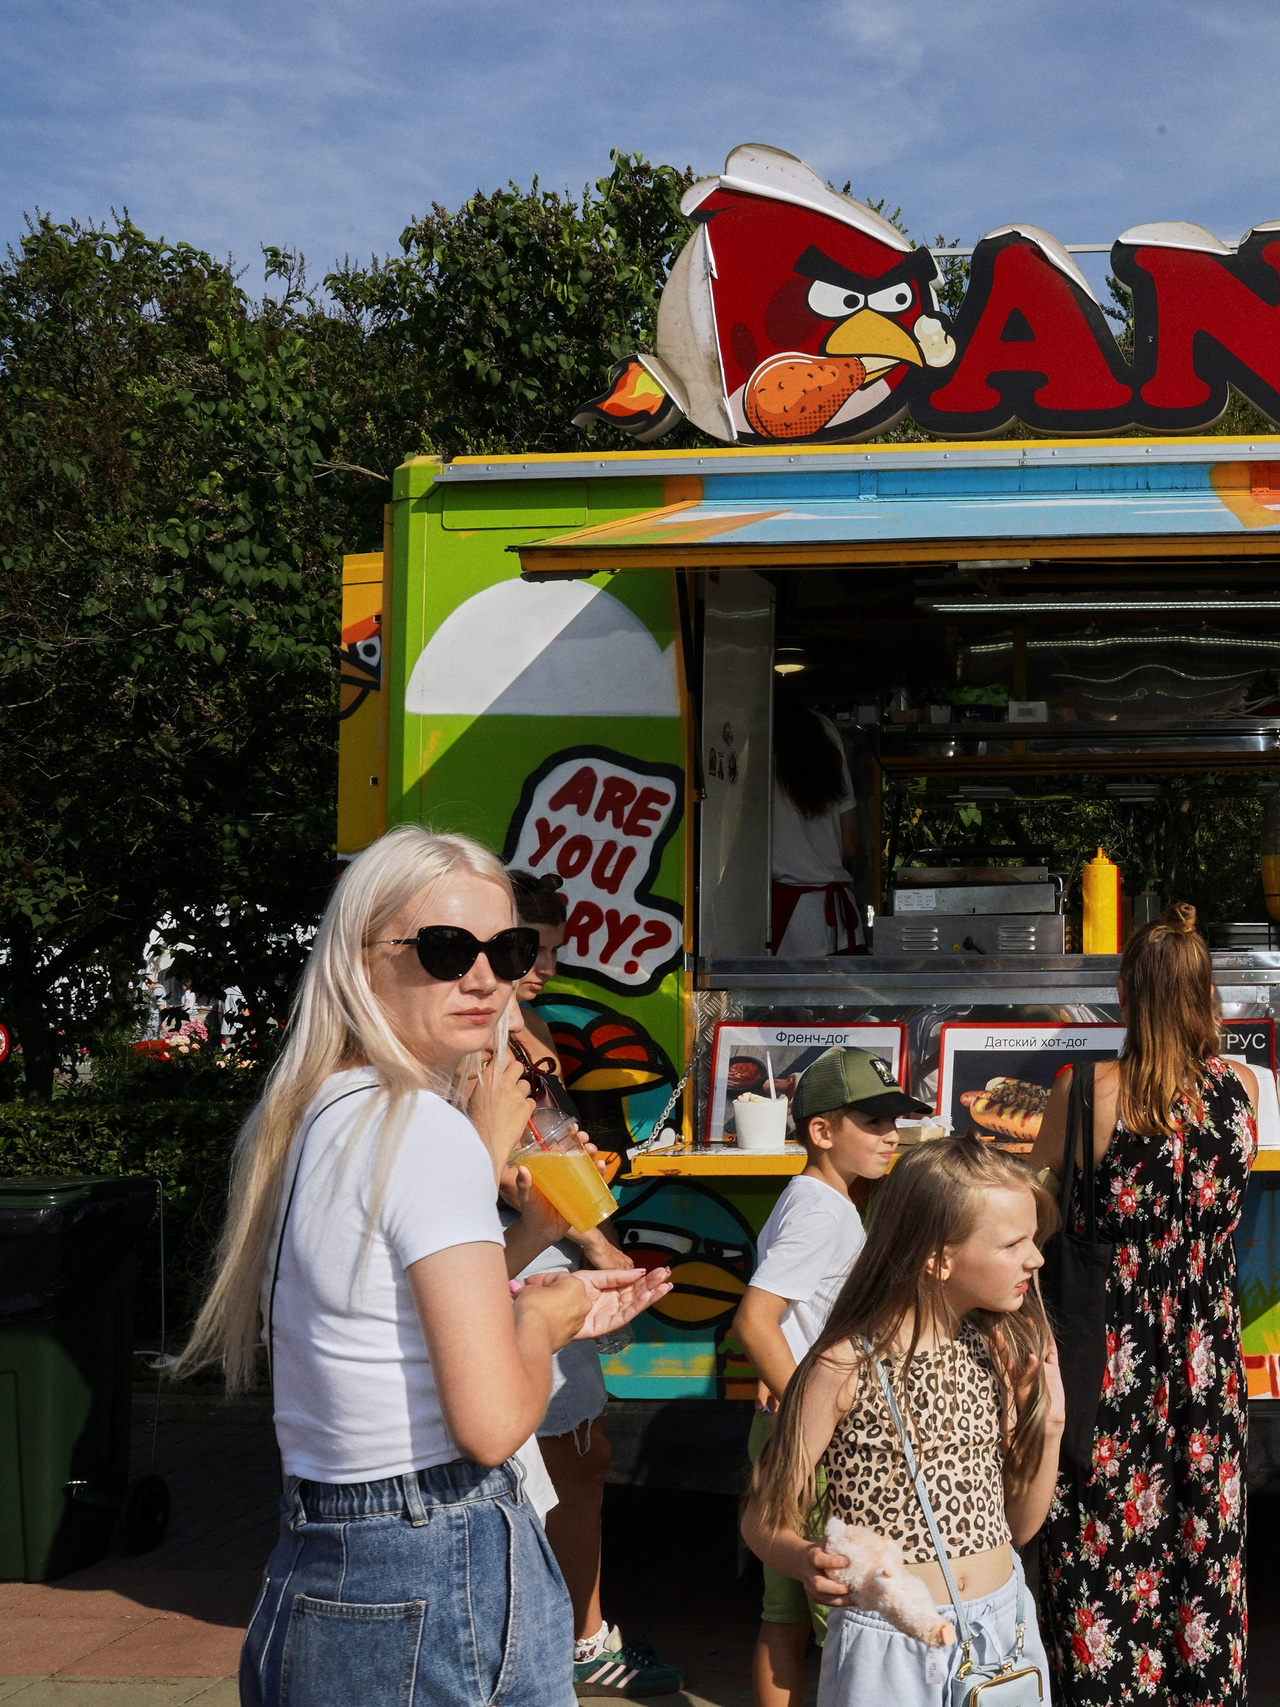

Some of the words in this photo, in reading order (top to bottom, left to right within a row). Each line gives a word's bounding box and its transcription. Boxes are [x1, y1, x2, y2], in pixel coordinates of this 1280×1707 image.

[548, 765, 671, 838] ARE
[528, 816, 637, 895] YOU
[558, 893, 672, 975] RY?
[775, 1031, 850, 1046] Френч-дог
[984, 1035, 1037, 1049] Датский
[1040, 1037, 1088, 1049] хот-дог
[1219, 1033, 1266, 1050] ТРУС
